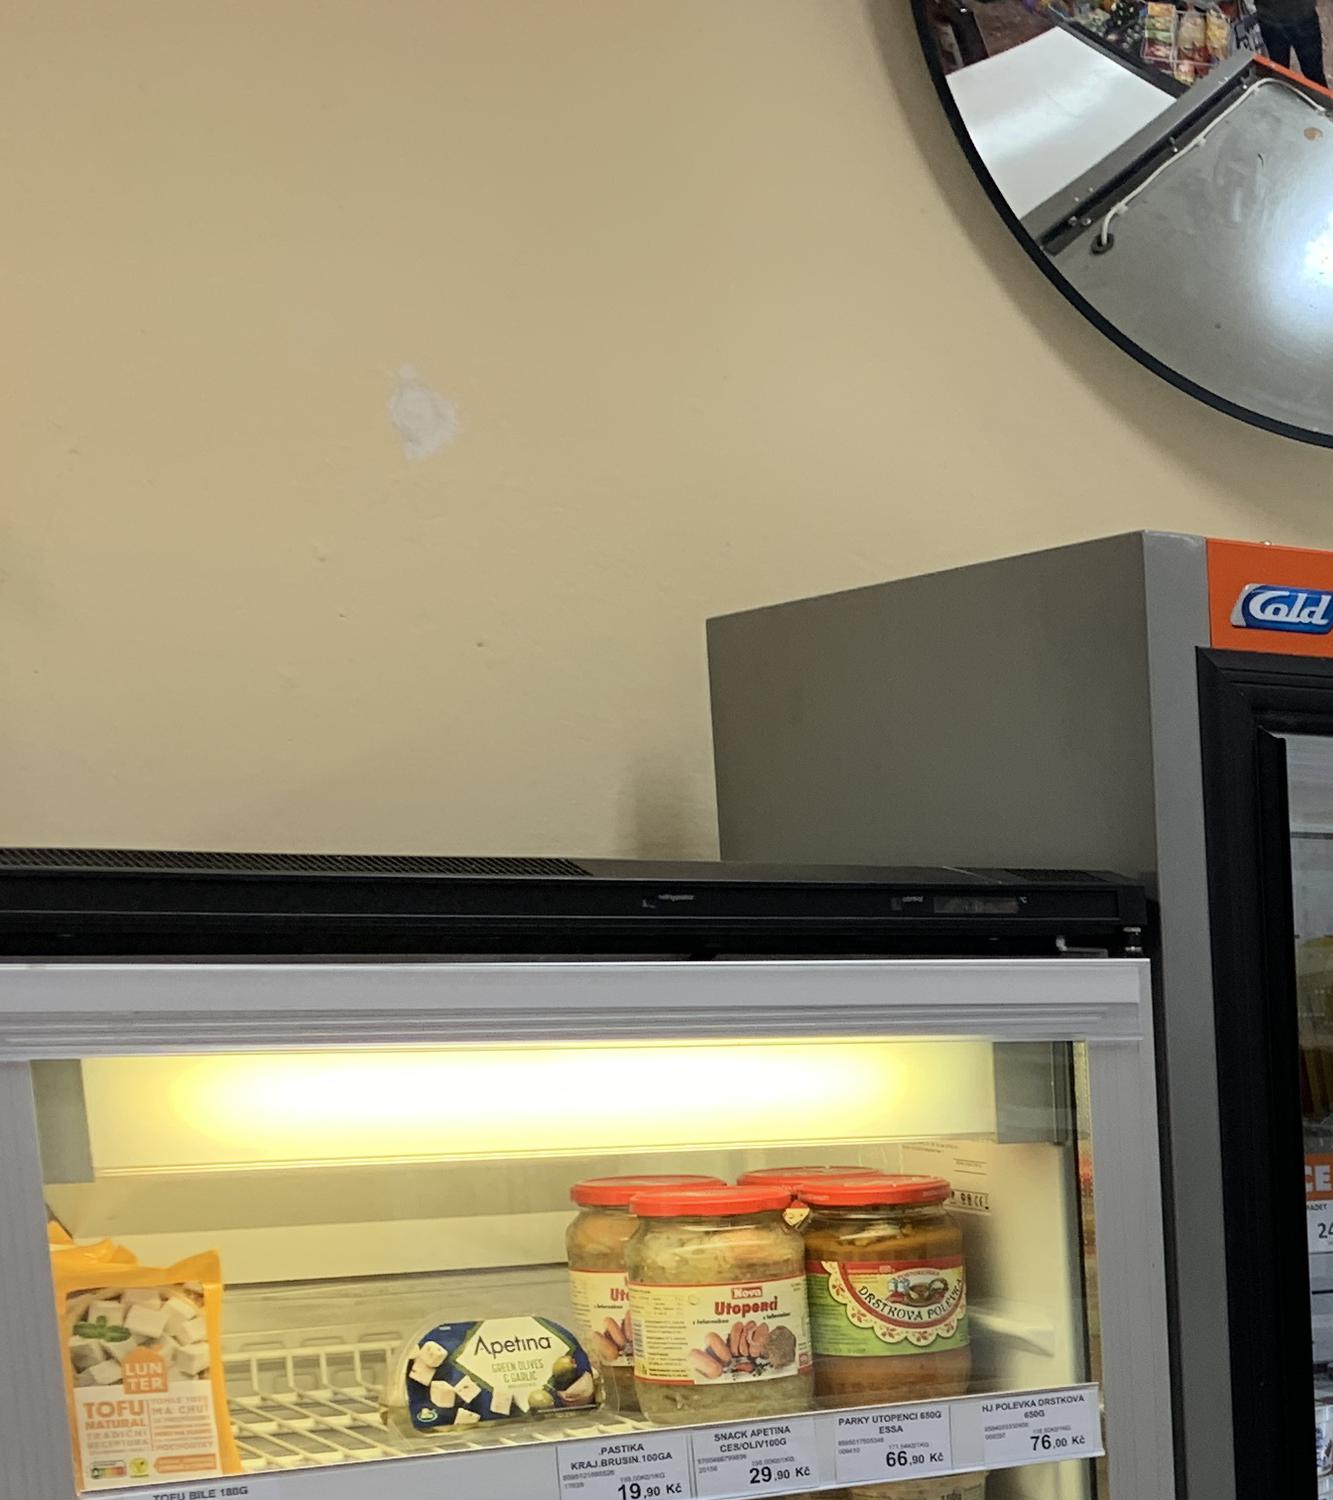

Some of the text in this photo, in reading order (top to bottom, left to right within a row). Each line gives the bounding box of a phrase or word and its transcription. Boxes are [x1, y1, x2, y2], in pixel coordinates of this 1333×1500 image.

[1250, 590, 1333, 625] Cold
[733, 1287, 761, 1298] Nova
[473, 1333, 552, 1359] Apetina
[124, 1362, 163, 1377] LUN
[128, 1377, 164, 1391] TER
[83, 1401, 144, 1418] TOFU
[996, 1400, 1036, 1411] POLEVKA
[1039, 1395, 1085, 1406] DRSTKOVA
[839, 1411, 942, 1426] PARKY UTOPENCI 650G
[1024, 1410, 1045, 1419] 650G
[84, 1418, 146, 1430] NATURAL
[879, 1424, 903, 1434] ESSA
[714, 1426, 791, 1441] SNACK APETINA
[1072, 1435, 1086, 1445] Kč
[929, 1453, 944, 1463] Kč
[666, 1483, 682, 1494] Kč
